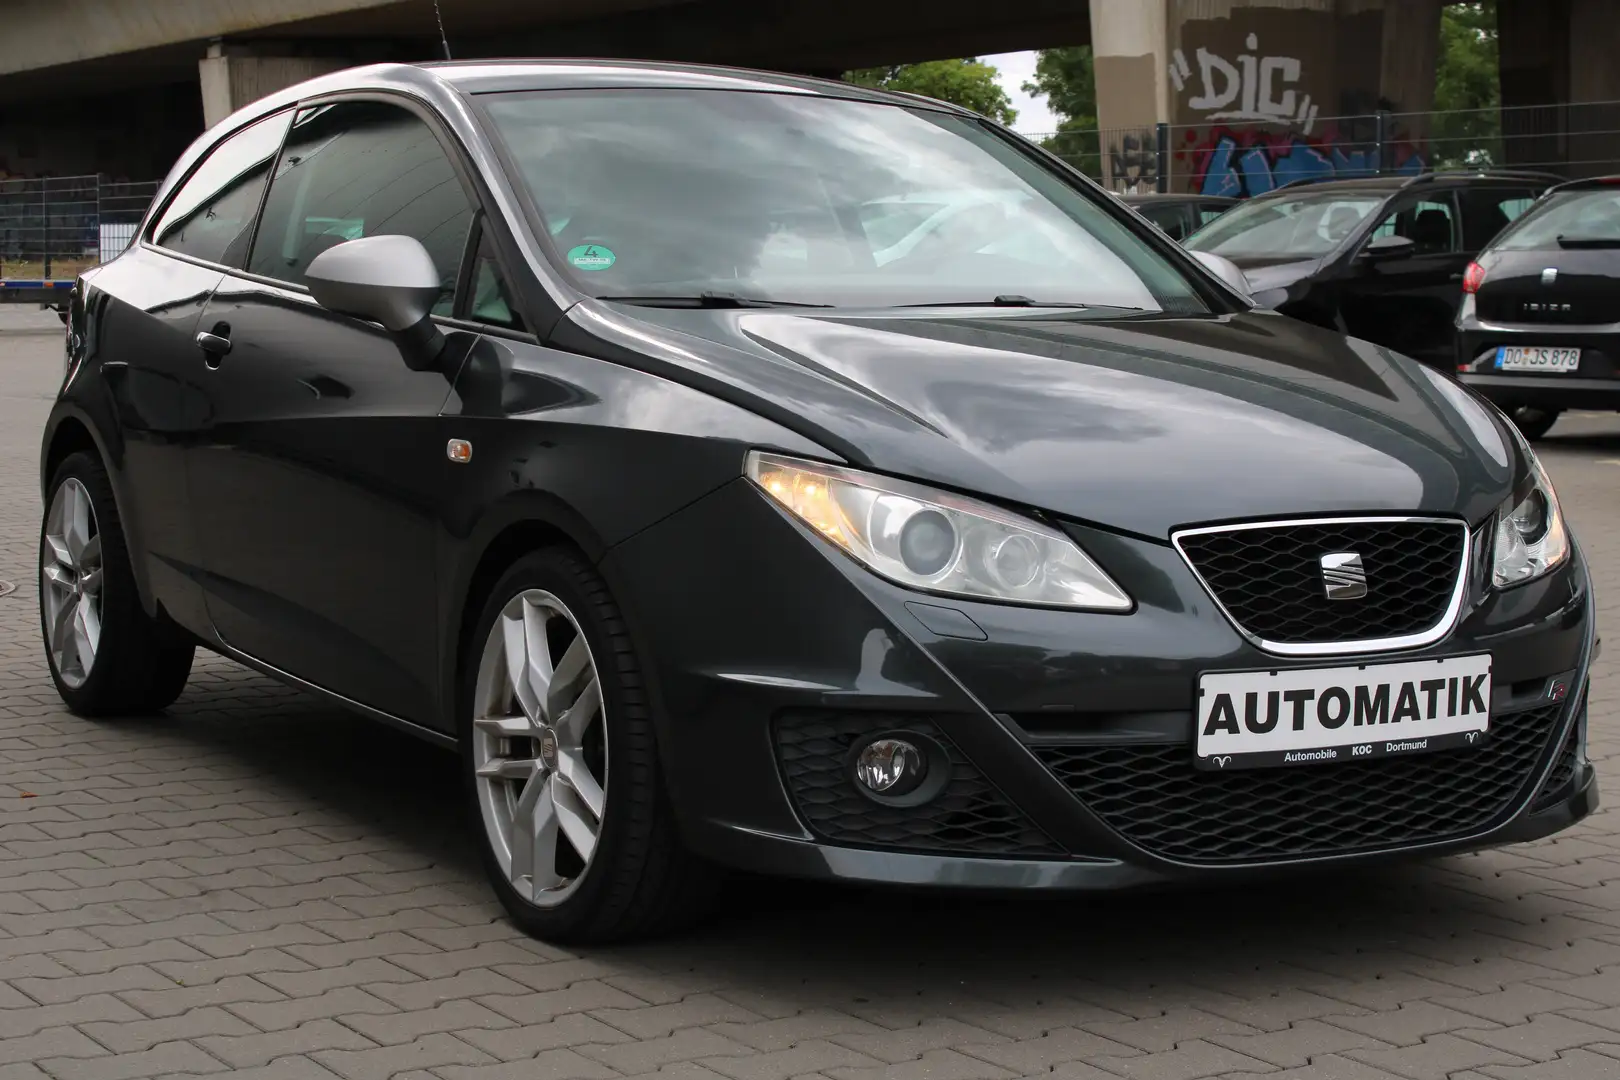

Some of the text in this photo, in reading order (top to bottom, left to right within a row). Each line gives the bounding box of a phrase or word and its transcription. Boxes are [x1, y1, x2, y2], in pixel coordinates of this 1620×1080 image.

[1504, 348, 1577, 366] DO JS 878
[1203, 673, 1488, 735] AUTOMATIK
[1284, 739, 1428, 762] Automobile KOC Dortmund
